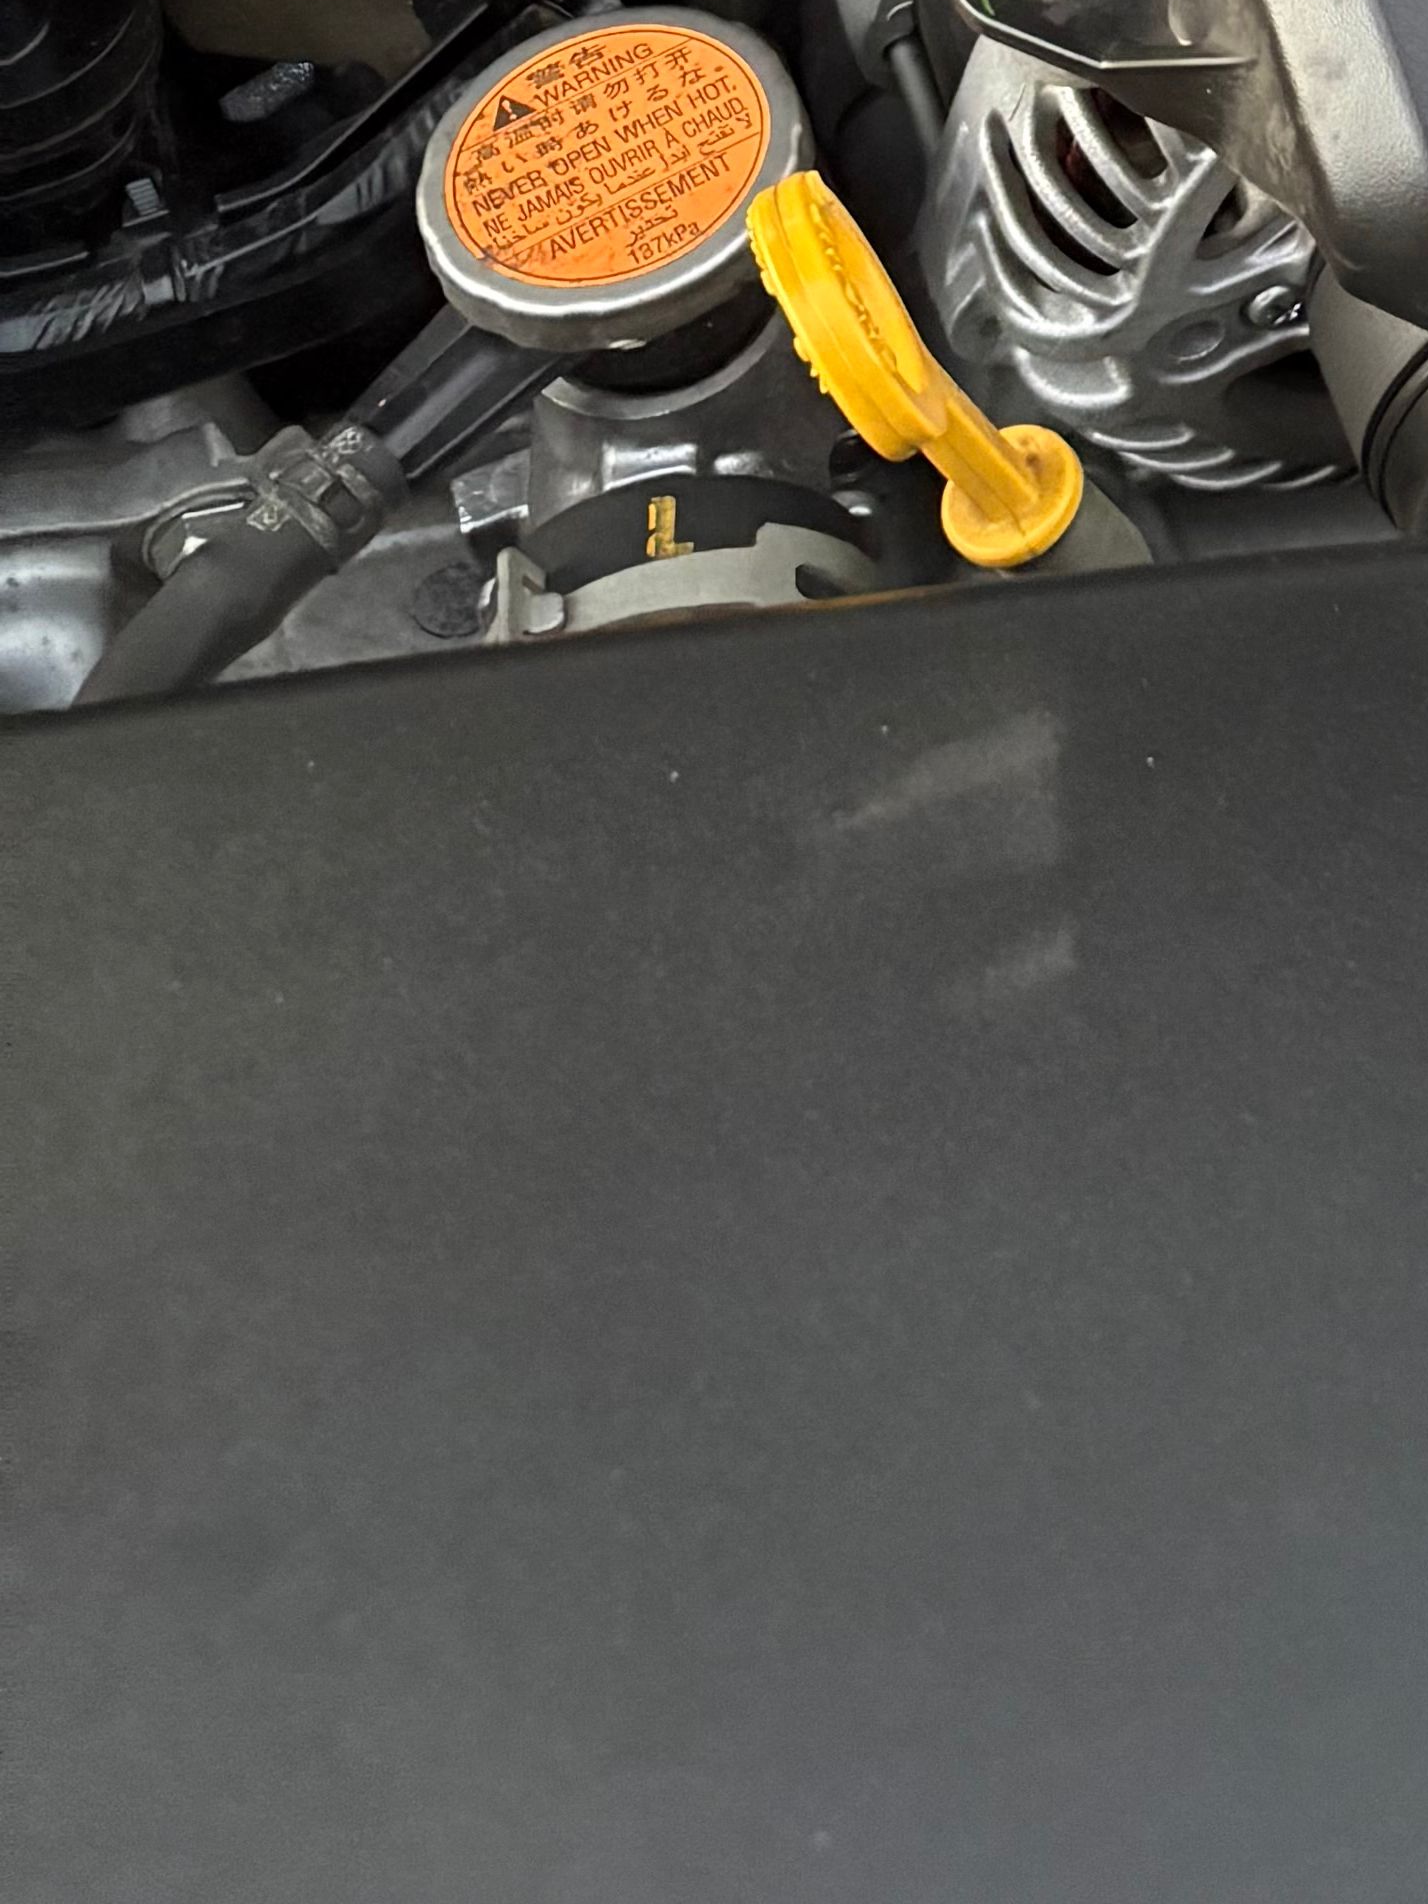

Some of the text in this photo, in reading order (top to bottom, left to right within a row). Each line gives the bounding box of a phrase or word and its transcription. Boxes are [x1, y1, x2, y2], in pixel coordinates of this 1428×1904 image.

[533, 41, 655, 109] WARNING
[472, 76, 737, 218] NEVER OPEN WHEN HOT.
[483, 212, 507, 238] NE
[517, 176, 585, 221] JAMAIS
[588, 139, 659, 186] OUVRIR
[664, 126, 680, 146] À
[549, 152, 732, 260] AVERTISSEMENT
